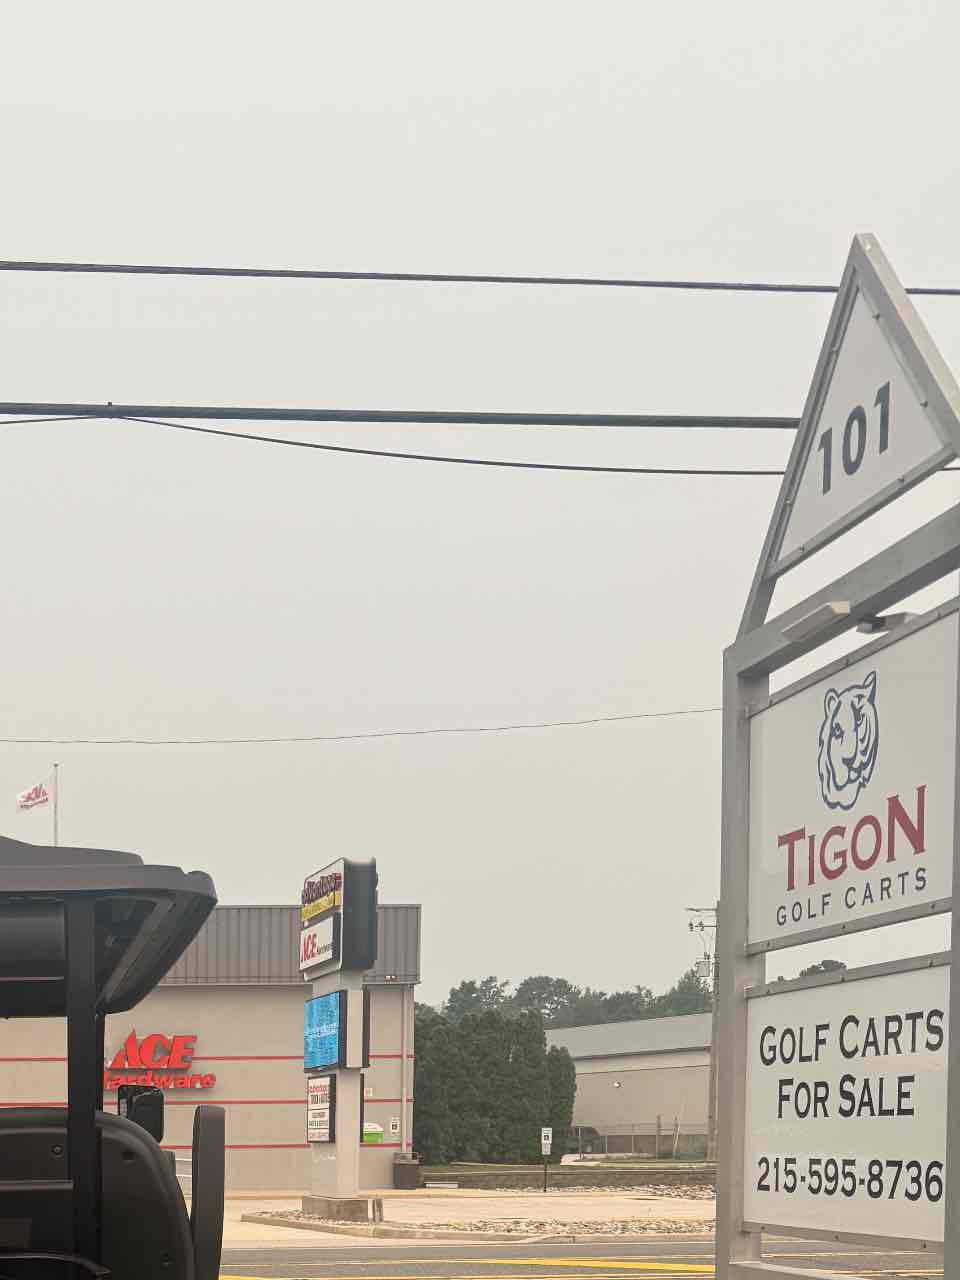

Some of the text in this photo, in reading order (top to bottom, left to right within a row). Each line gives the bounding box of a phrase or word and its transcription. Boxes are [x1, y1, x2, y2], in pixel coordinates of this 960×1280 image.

[818, 381, 890, 496] 101
[777, 784, 927, 891] TIGON
[776, 867, 927, 926] GOLF CARTS
[109, 1029, 197, 1070] ACE
[760, 1009, 944, 1066] GOLF CARTS
[777, 1074, 915, 1119] FOR SALE
[756, 1156, 943, 1202] 215-595-8736
